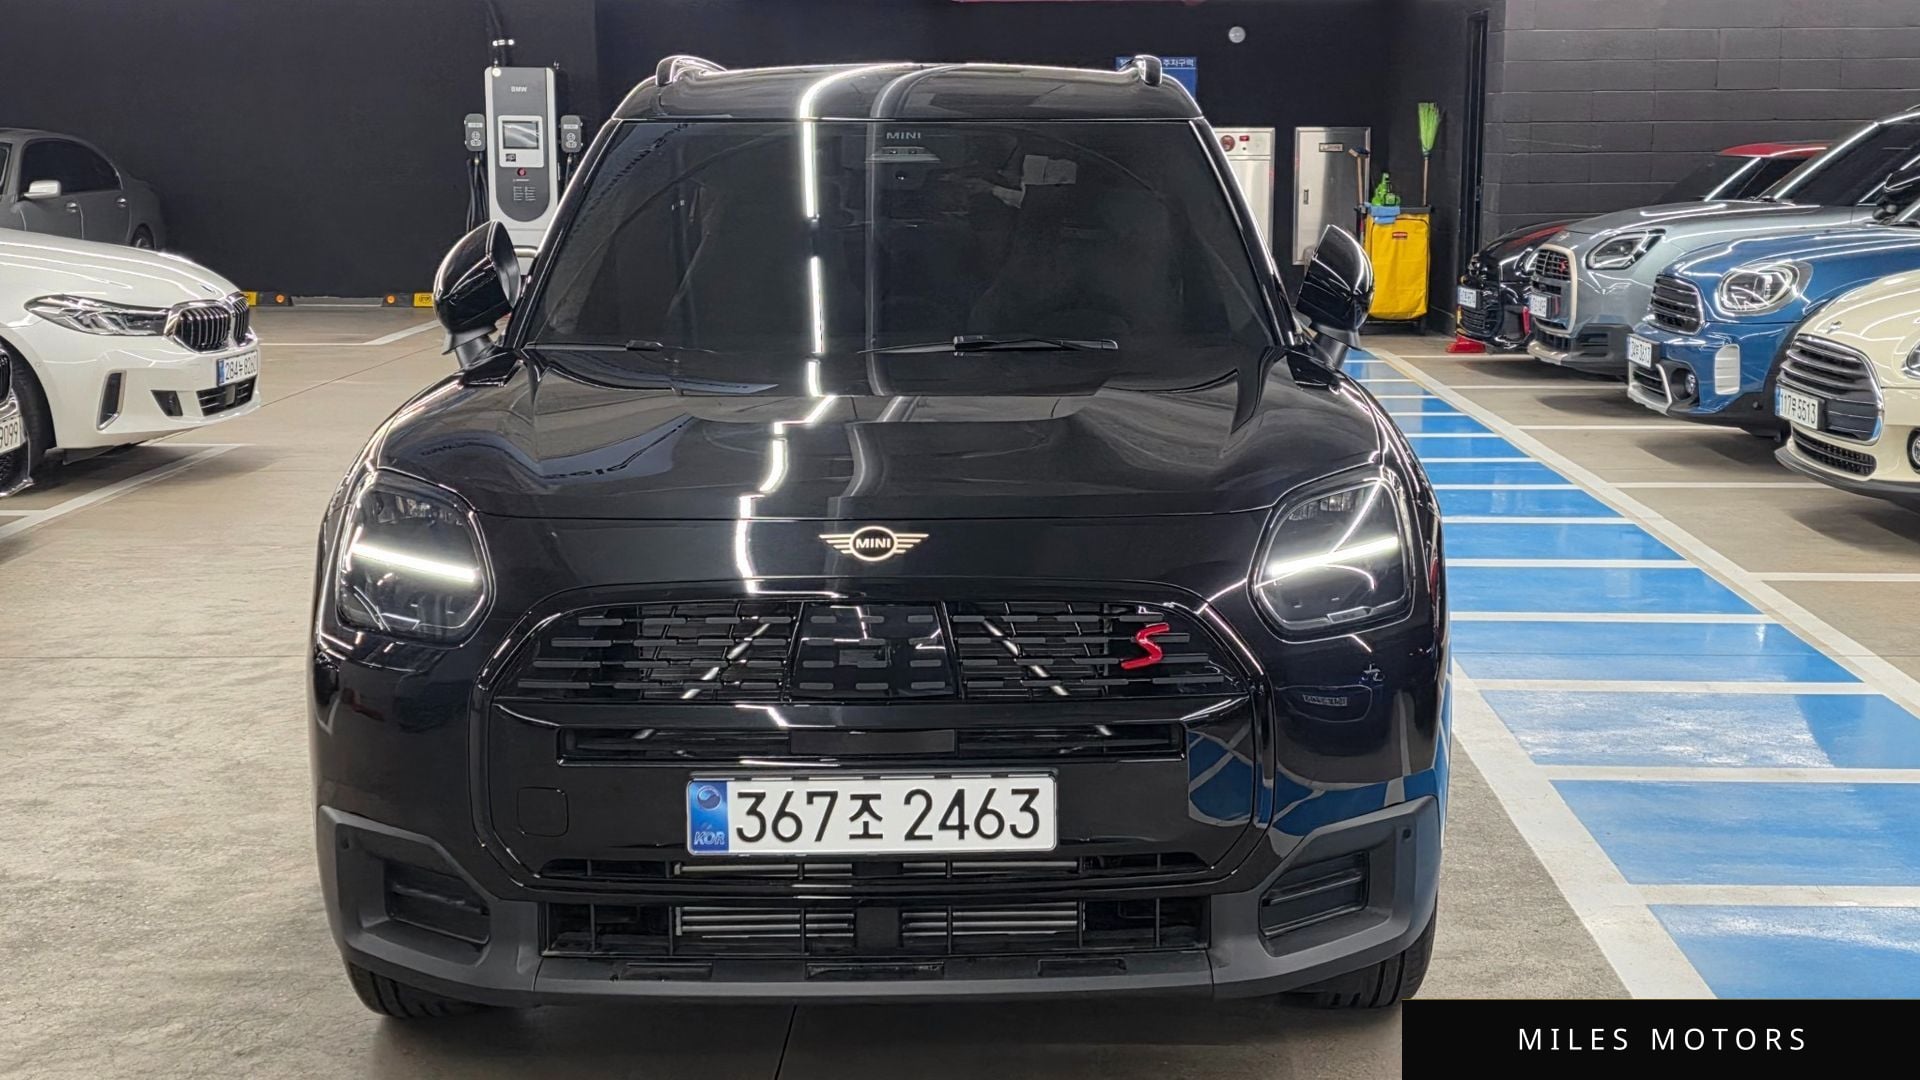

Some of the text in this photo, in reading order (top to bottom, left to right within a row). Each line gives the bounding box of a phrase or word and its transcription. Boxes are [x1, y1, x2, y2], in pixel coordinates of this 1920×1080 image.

[855, 538, 892, 549] MINI
[1121, 622, 1170, 669] S
[737, 787, 1041, 843] 367조 2463
[694, 831, 726, 845] KOR
